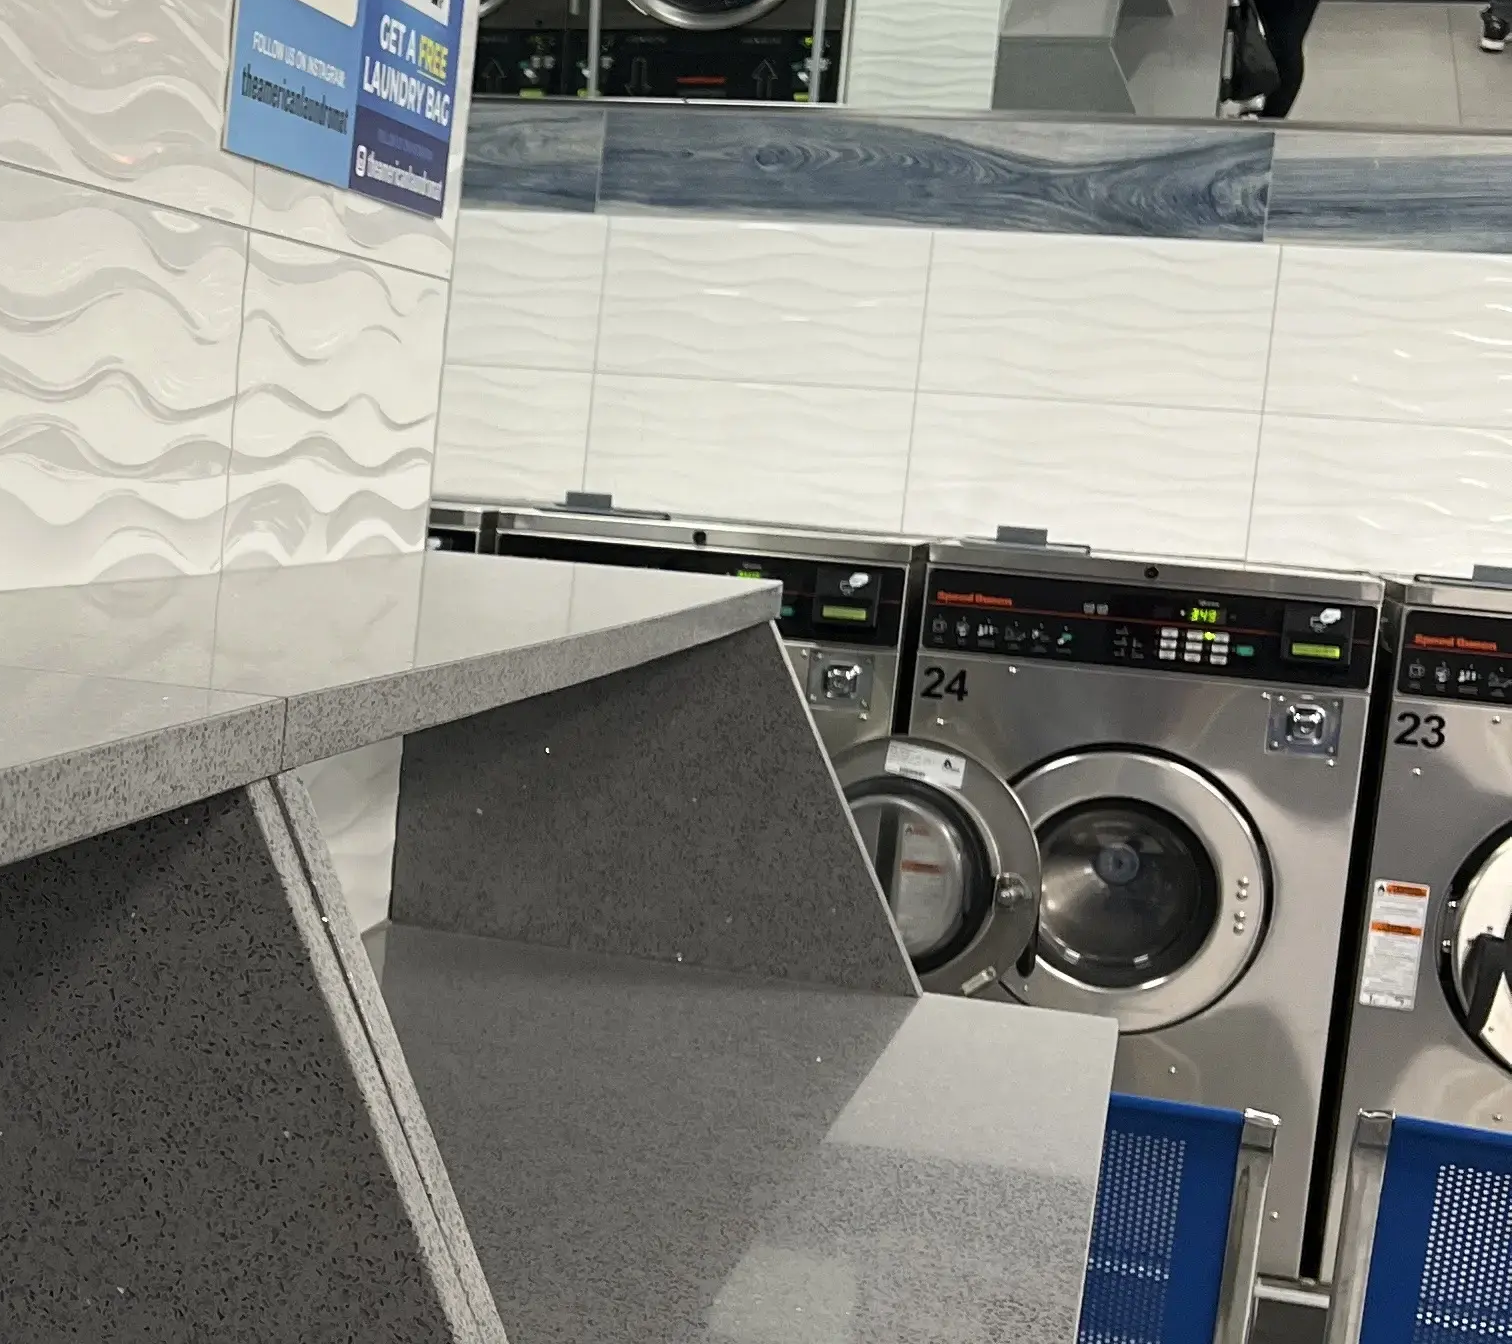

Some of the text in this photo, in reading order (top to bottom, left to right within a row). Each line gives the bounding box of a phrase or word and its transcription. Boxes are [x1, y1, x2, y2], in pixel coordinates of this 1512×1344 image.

[252, 30, 285, 61] FOLLOW
[284, 44, 296, 69] US
[295, 50, 307, 75] ON
[380, 14, 448, 80] GET A FREE
[362, 56, 451, 127] LAUNDRY BAG
[920, 667, 969, 702] 24
[1393, 711, 1446, 749] 23
